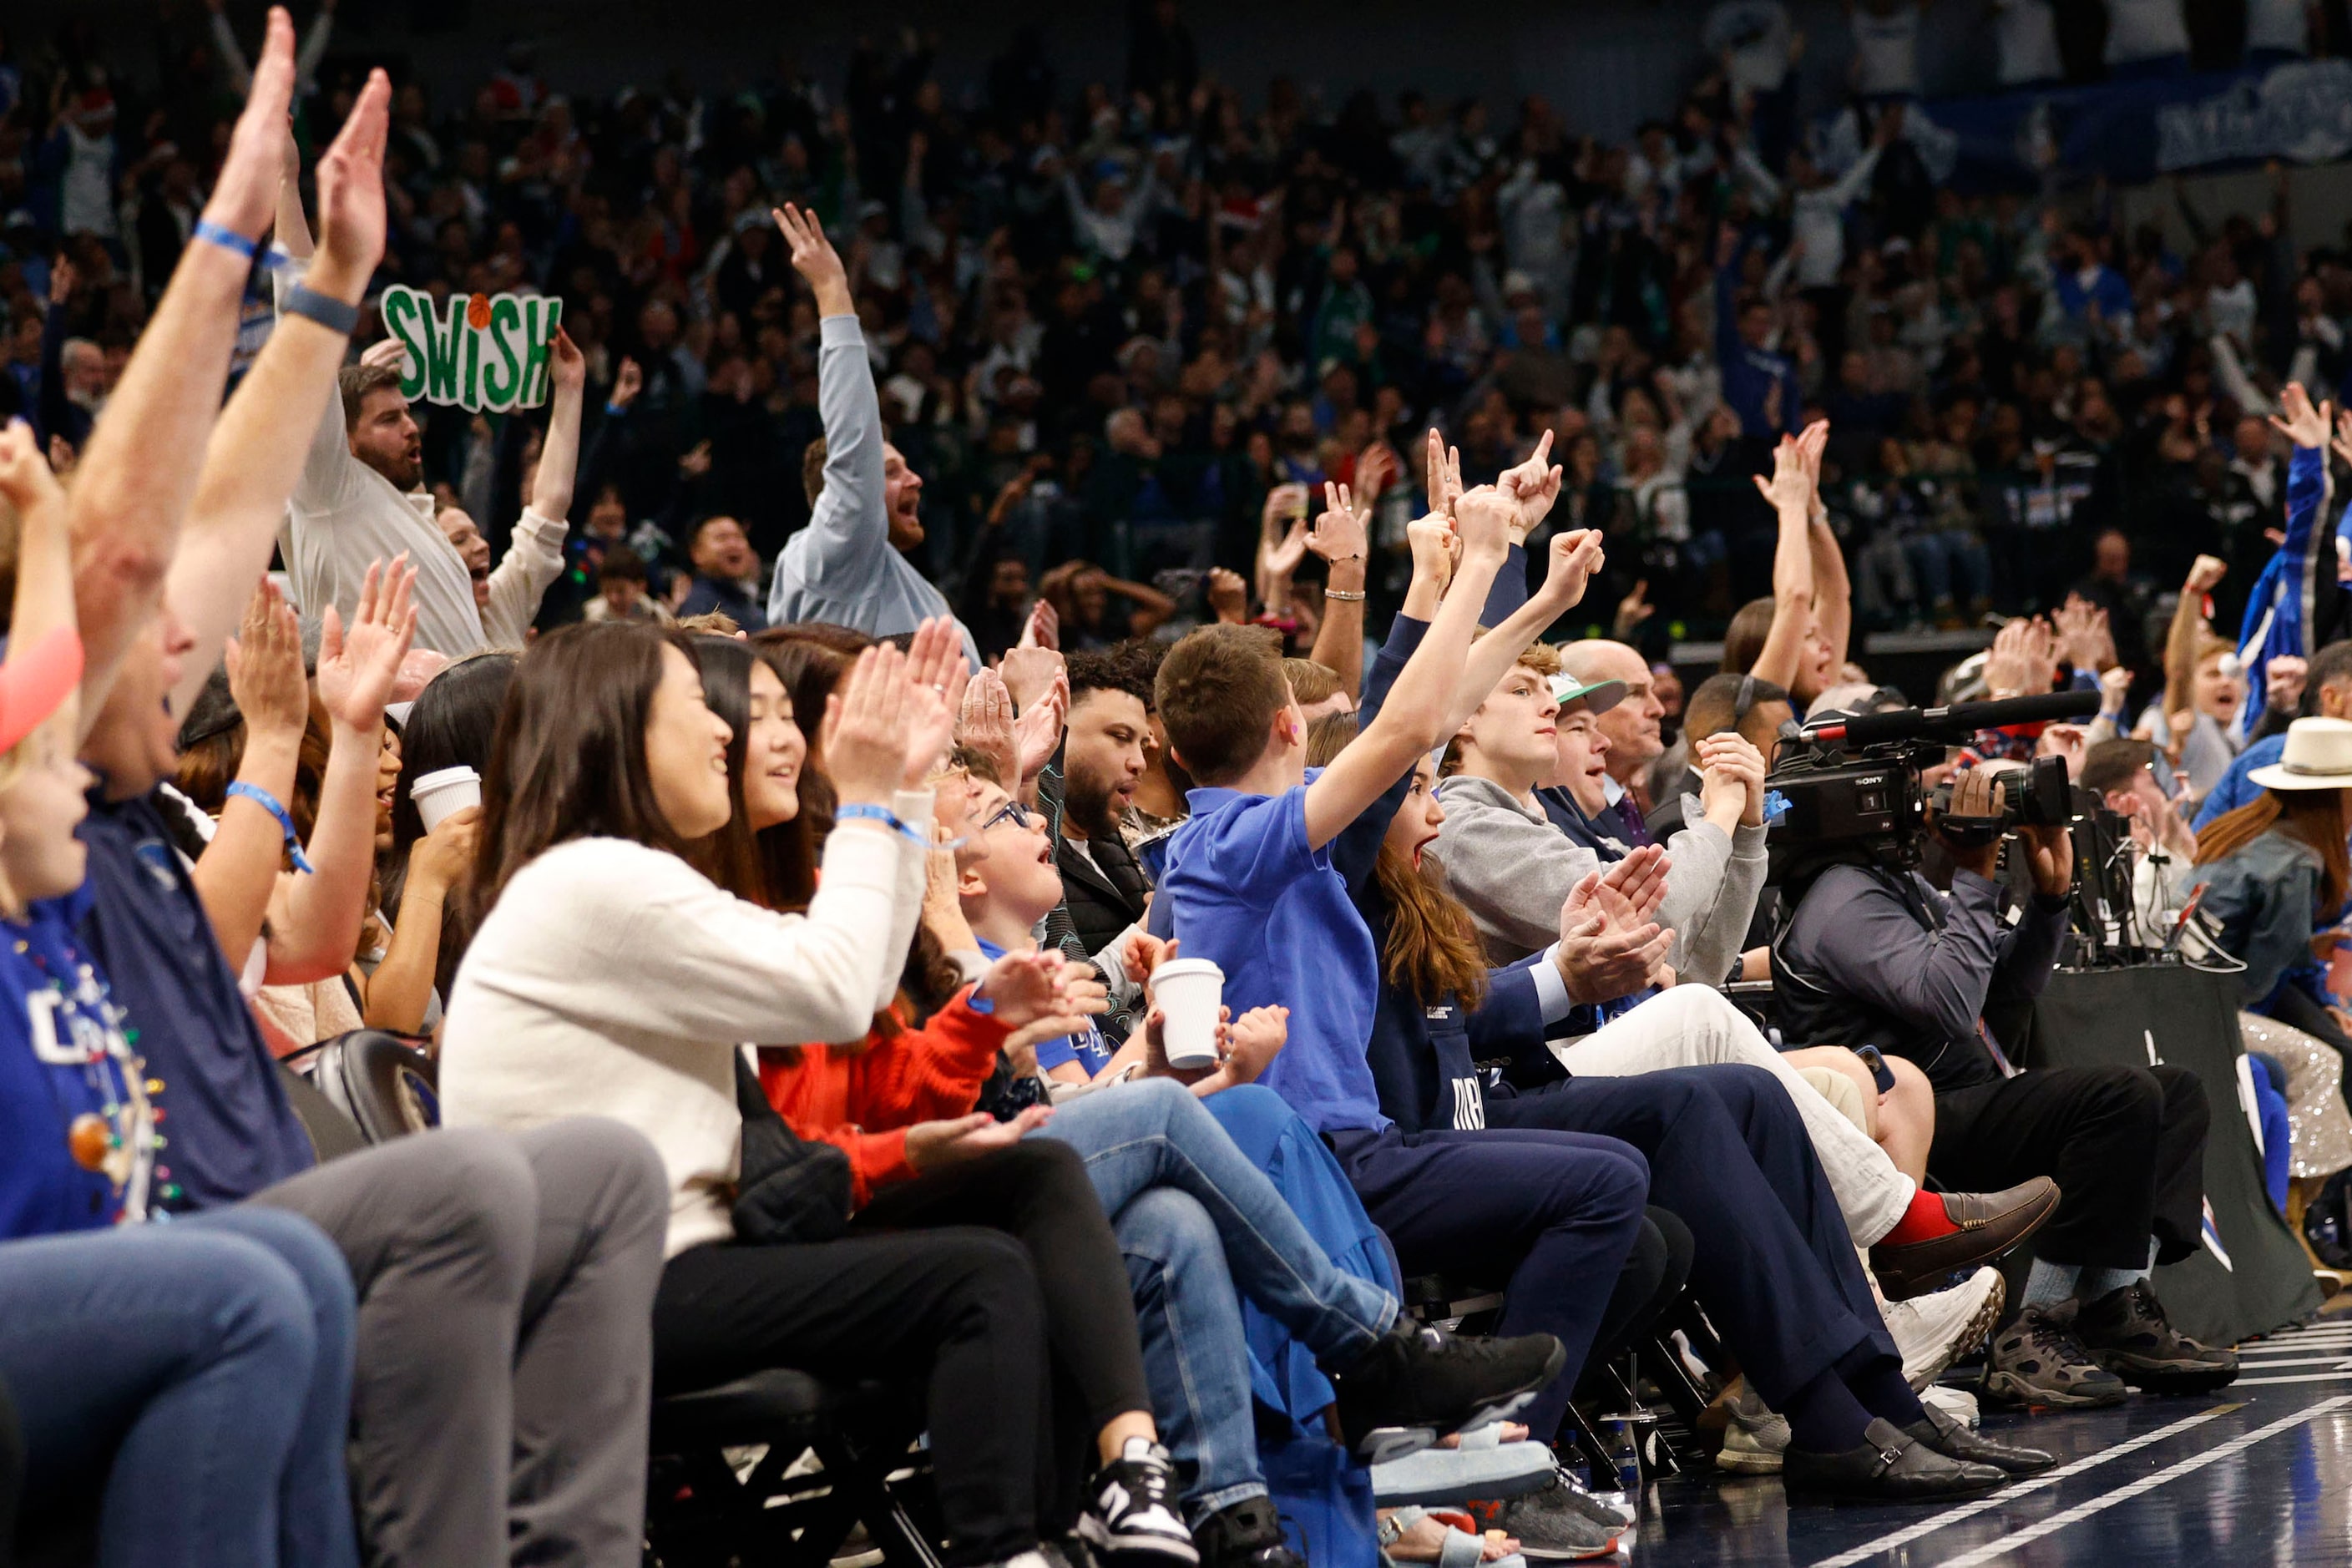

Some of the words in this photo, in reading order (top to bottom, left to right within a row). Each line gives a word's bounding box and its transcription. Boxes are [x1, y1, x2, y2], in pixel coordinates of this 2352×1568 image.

[385, 289, 561, 409] SWISH
[1854, 776, 1884, 787] SONY
[1868, 796, 1875, 807] 1
